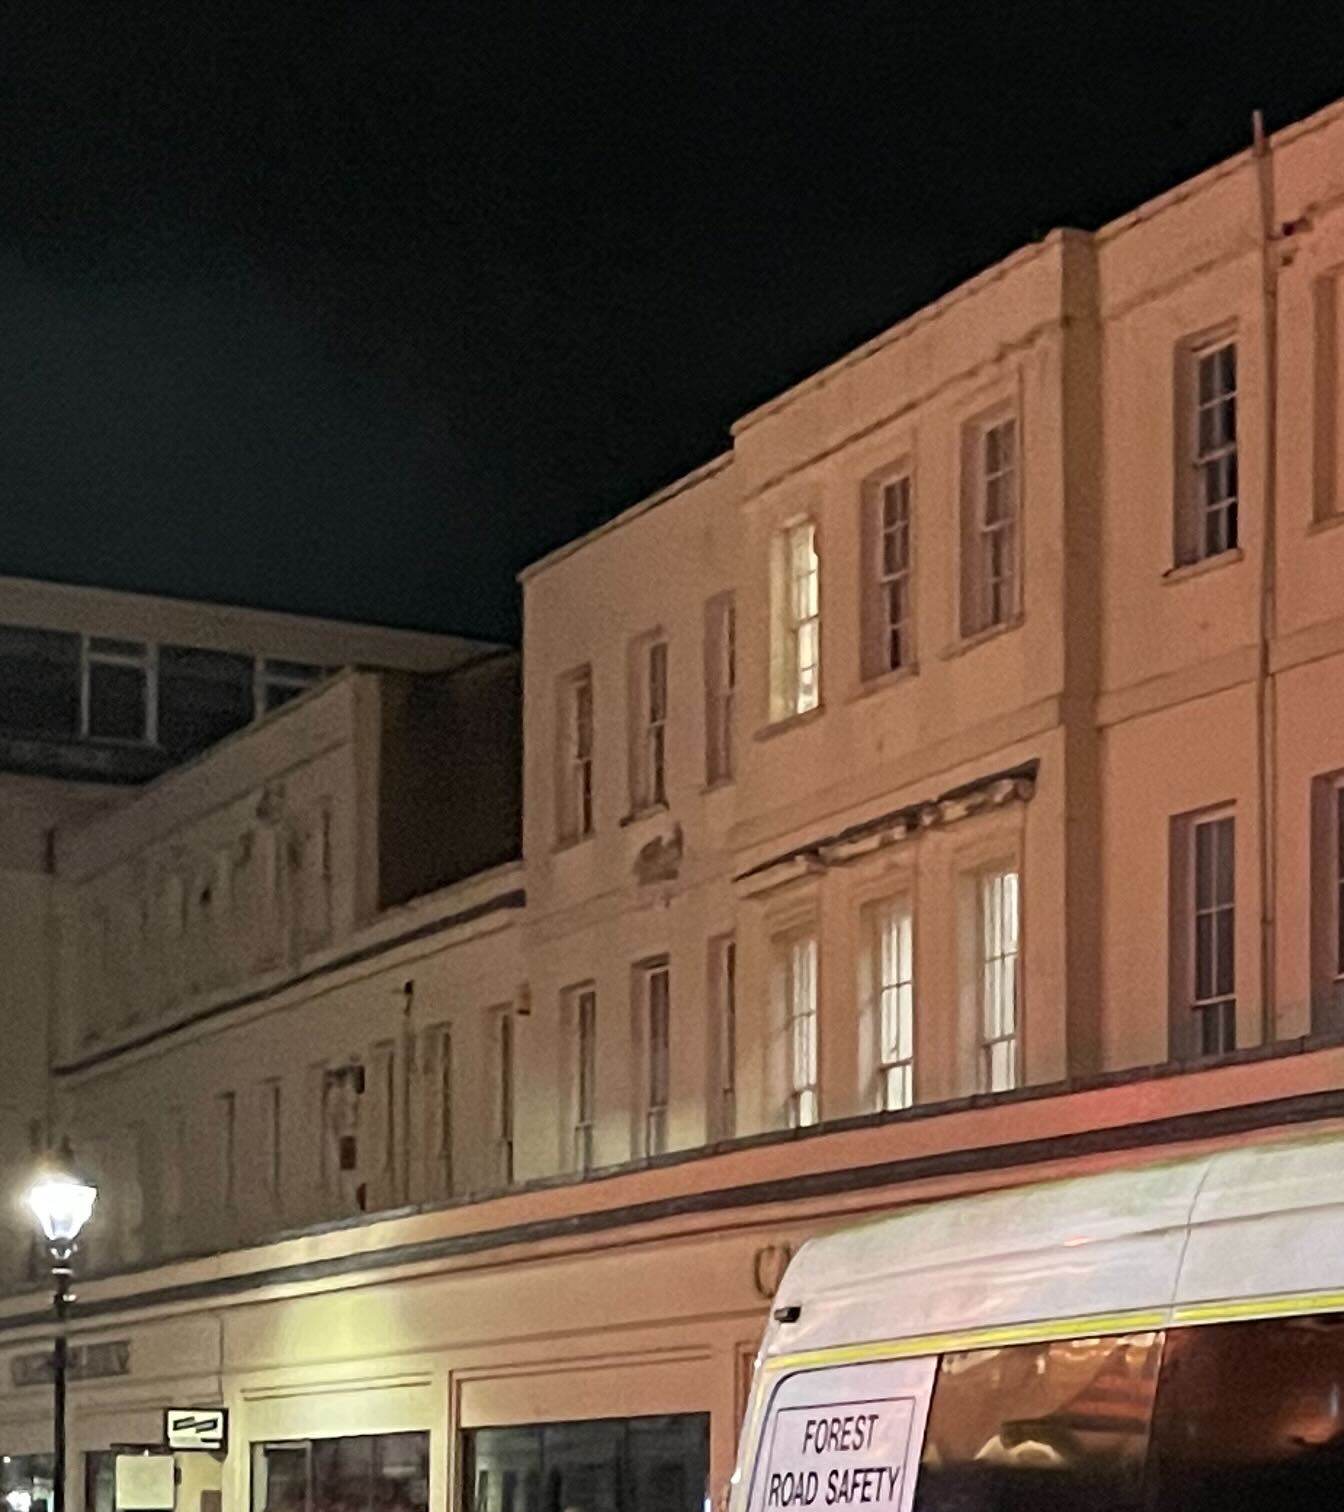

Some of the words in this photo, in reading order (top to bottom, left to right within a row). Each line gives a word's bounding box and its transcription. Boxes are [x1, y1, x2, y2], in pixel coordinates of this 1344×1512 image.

[802, 1414, 879, 1454] FOREST
[768, 1471, 818, 1507] ROAD
[826, 1466, 900, 1505] SAFETY
